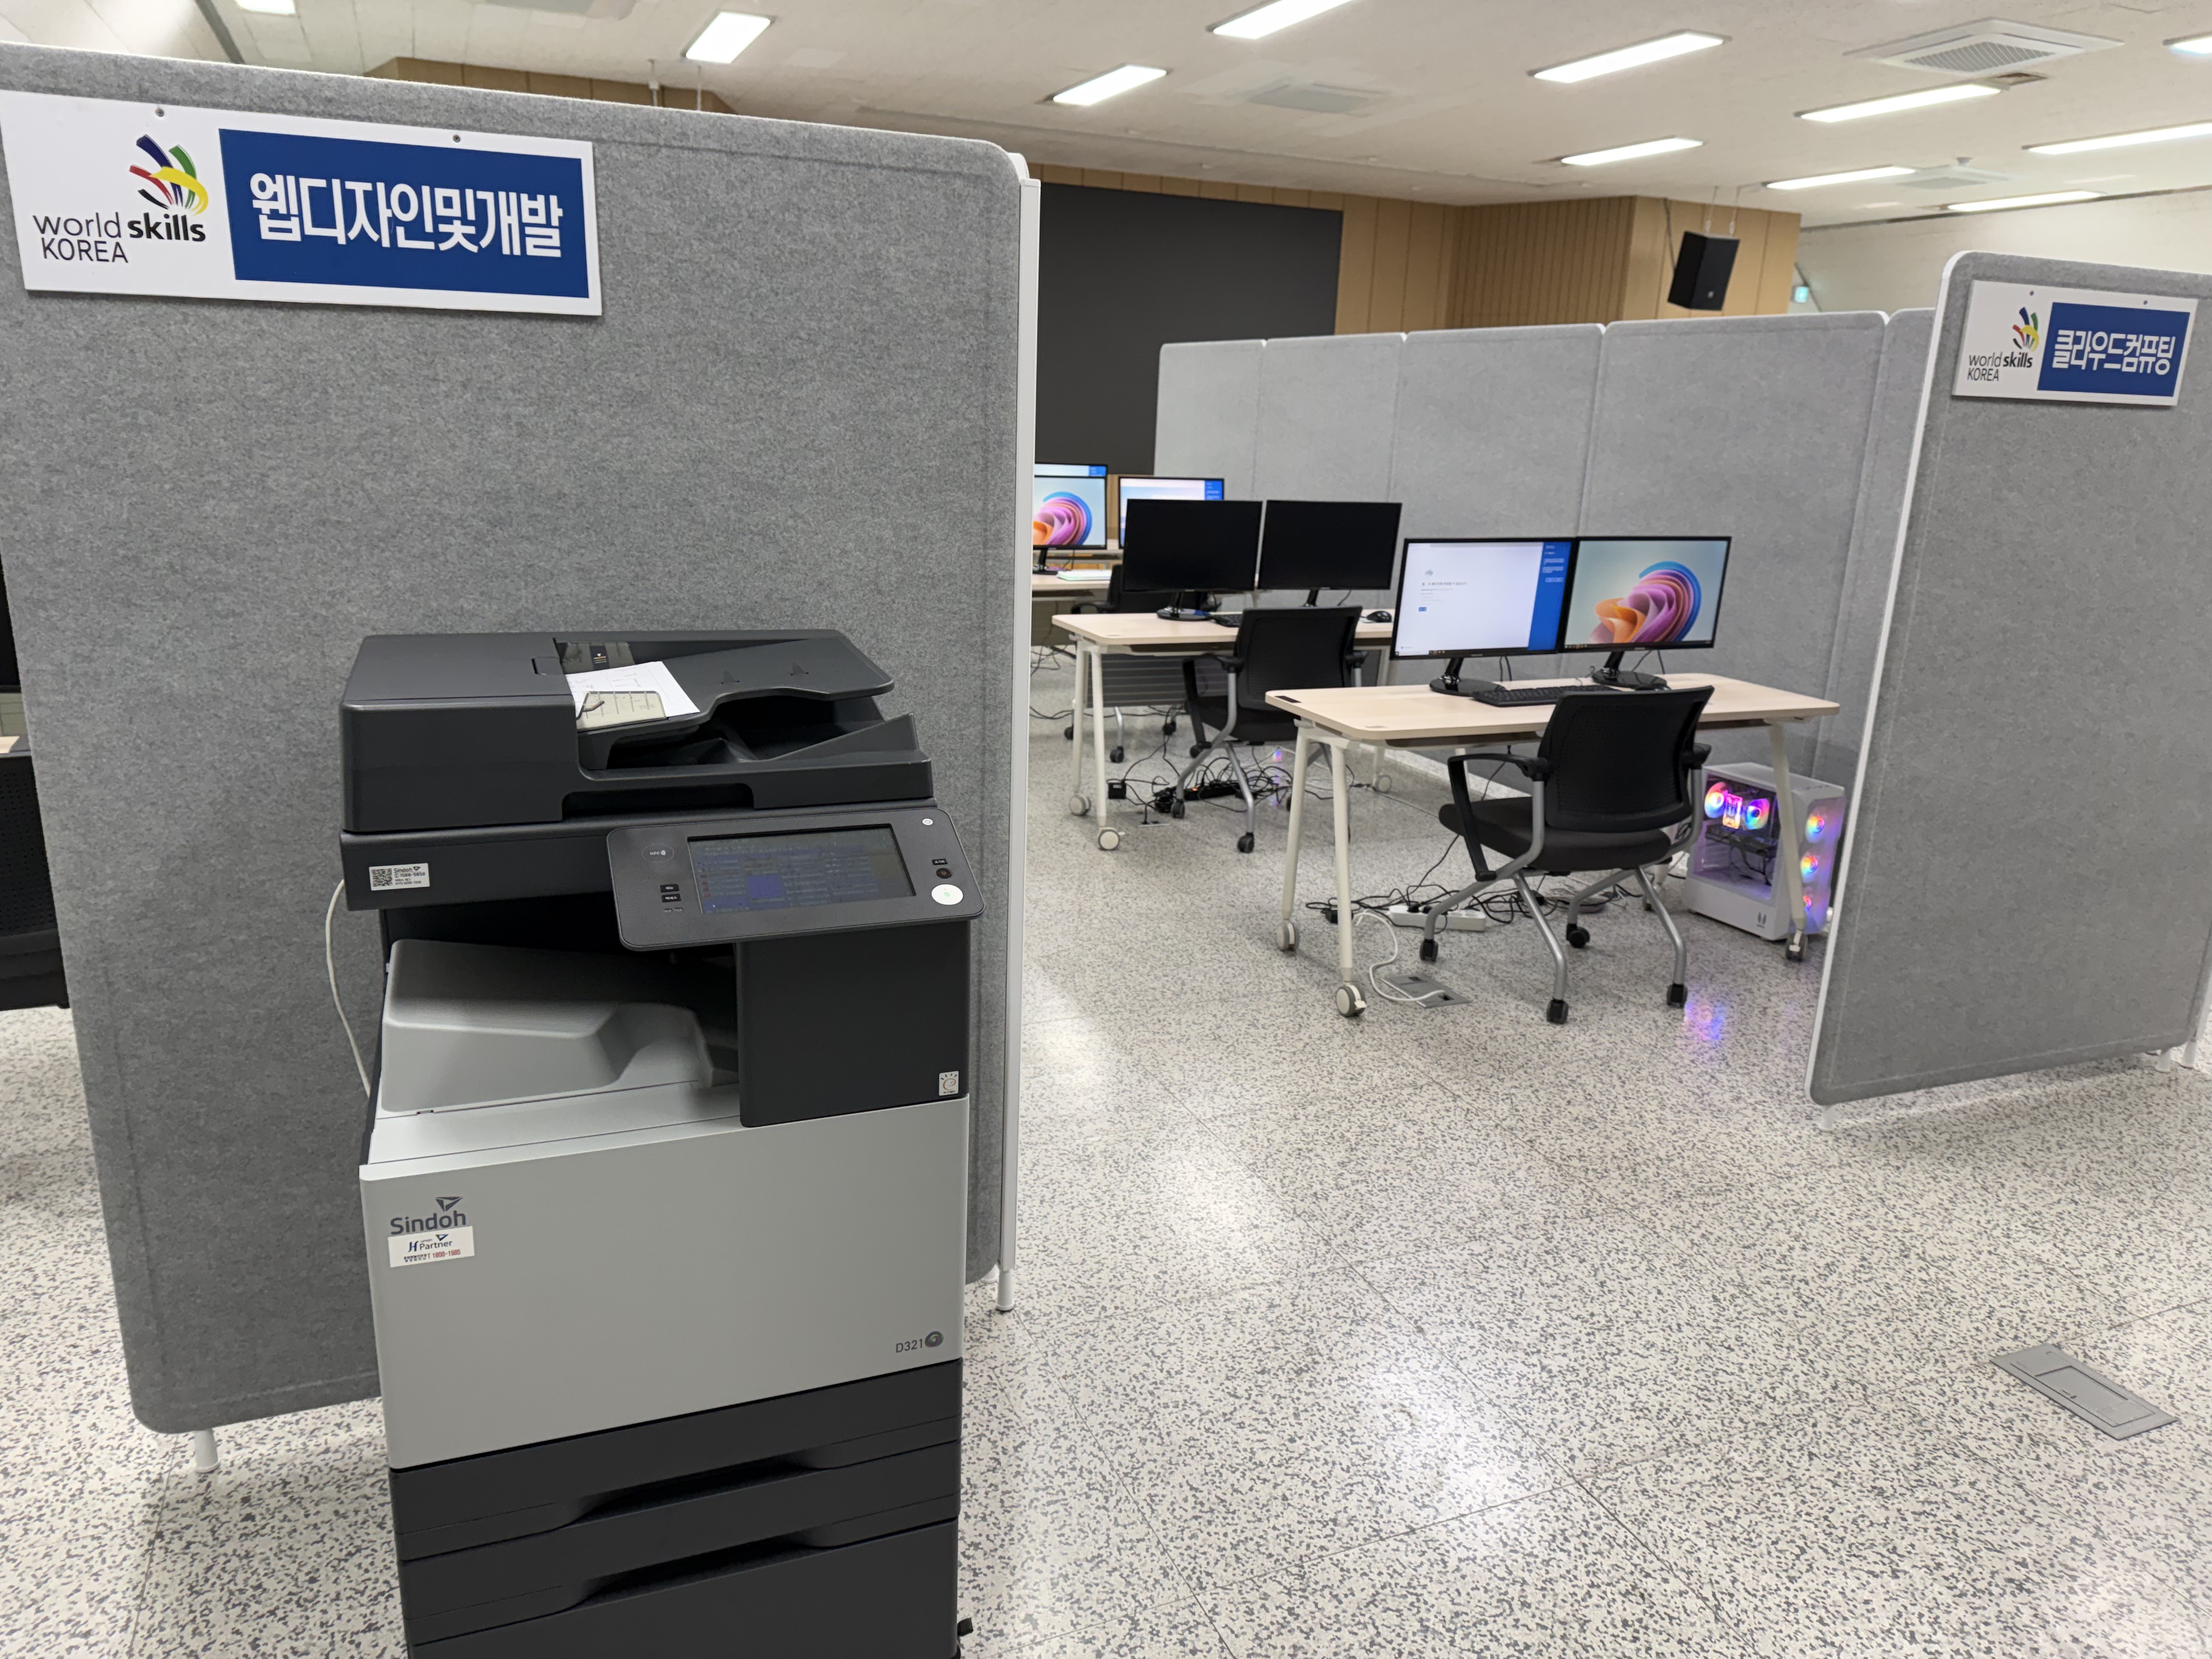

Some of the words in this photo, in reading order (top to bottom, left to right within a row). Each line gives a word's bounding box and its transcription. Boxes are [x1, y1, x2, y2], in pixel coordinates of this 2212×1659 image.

[250, 172, 563, 257] 웹디자인및개발
[41, 237, 128, 263] KOREA
[2052, 329, 2176, 375] 클라우드컴퓨팅
[1967, 368, 1999, 381] KOREA
[390, 1210, 466, 1235] Sindoh
[420, 1240, 453, 1250] Partner
[896, 1339, 923, 1353] D321
